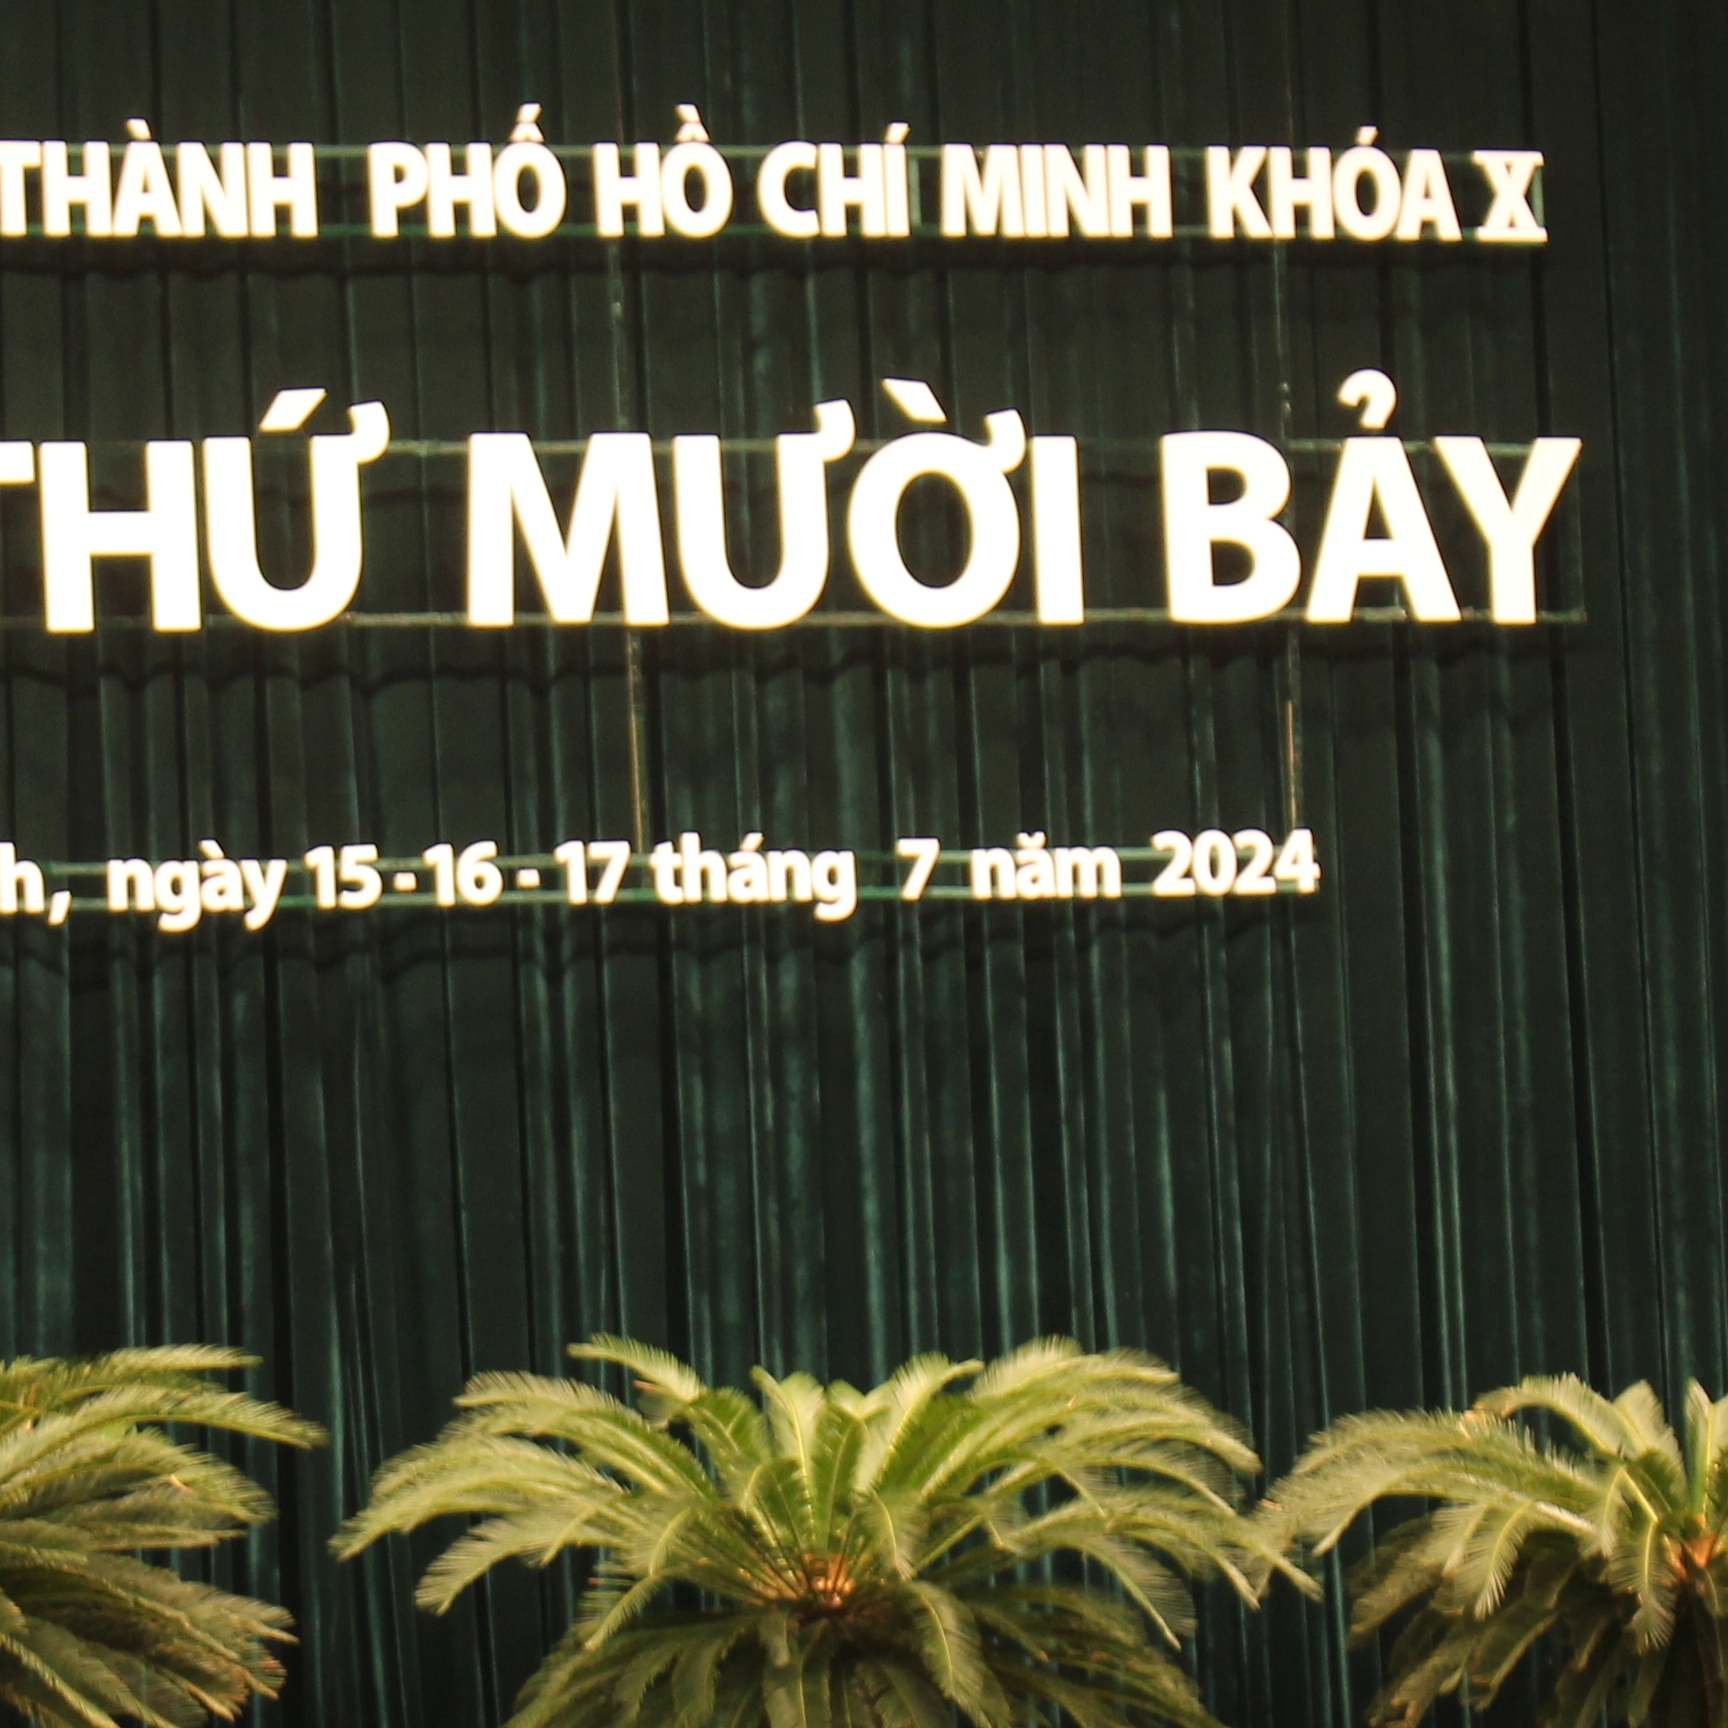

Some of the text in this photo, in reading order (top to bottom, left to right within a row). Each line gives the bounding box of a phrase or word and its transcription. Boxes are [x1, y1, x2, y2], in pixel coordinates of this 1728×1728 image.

[367, 102, 567, 237] PHỐ
[592, 103, 733, 237] HỒ
[757, 121, 910, 237] CHÍ
[941, 142, 1173, 237] MINH
[1206, 125, 1462, 239] KHÓA
[1472, 148, 1548, 241] X
[467, 377, 1085, 629] MƯỜI
[1161, 368, 1582, 623] BẢY
[105, 838, 288, 931] ngày
[647, 831, 858, 920] tháng
[896, 837, 941, 900] 7
[967, 830, 1123, 899] năm
[1150, 827, 1321, 896] 2024
